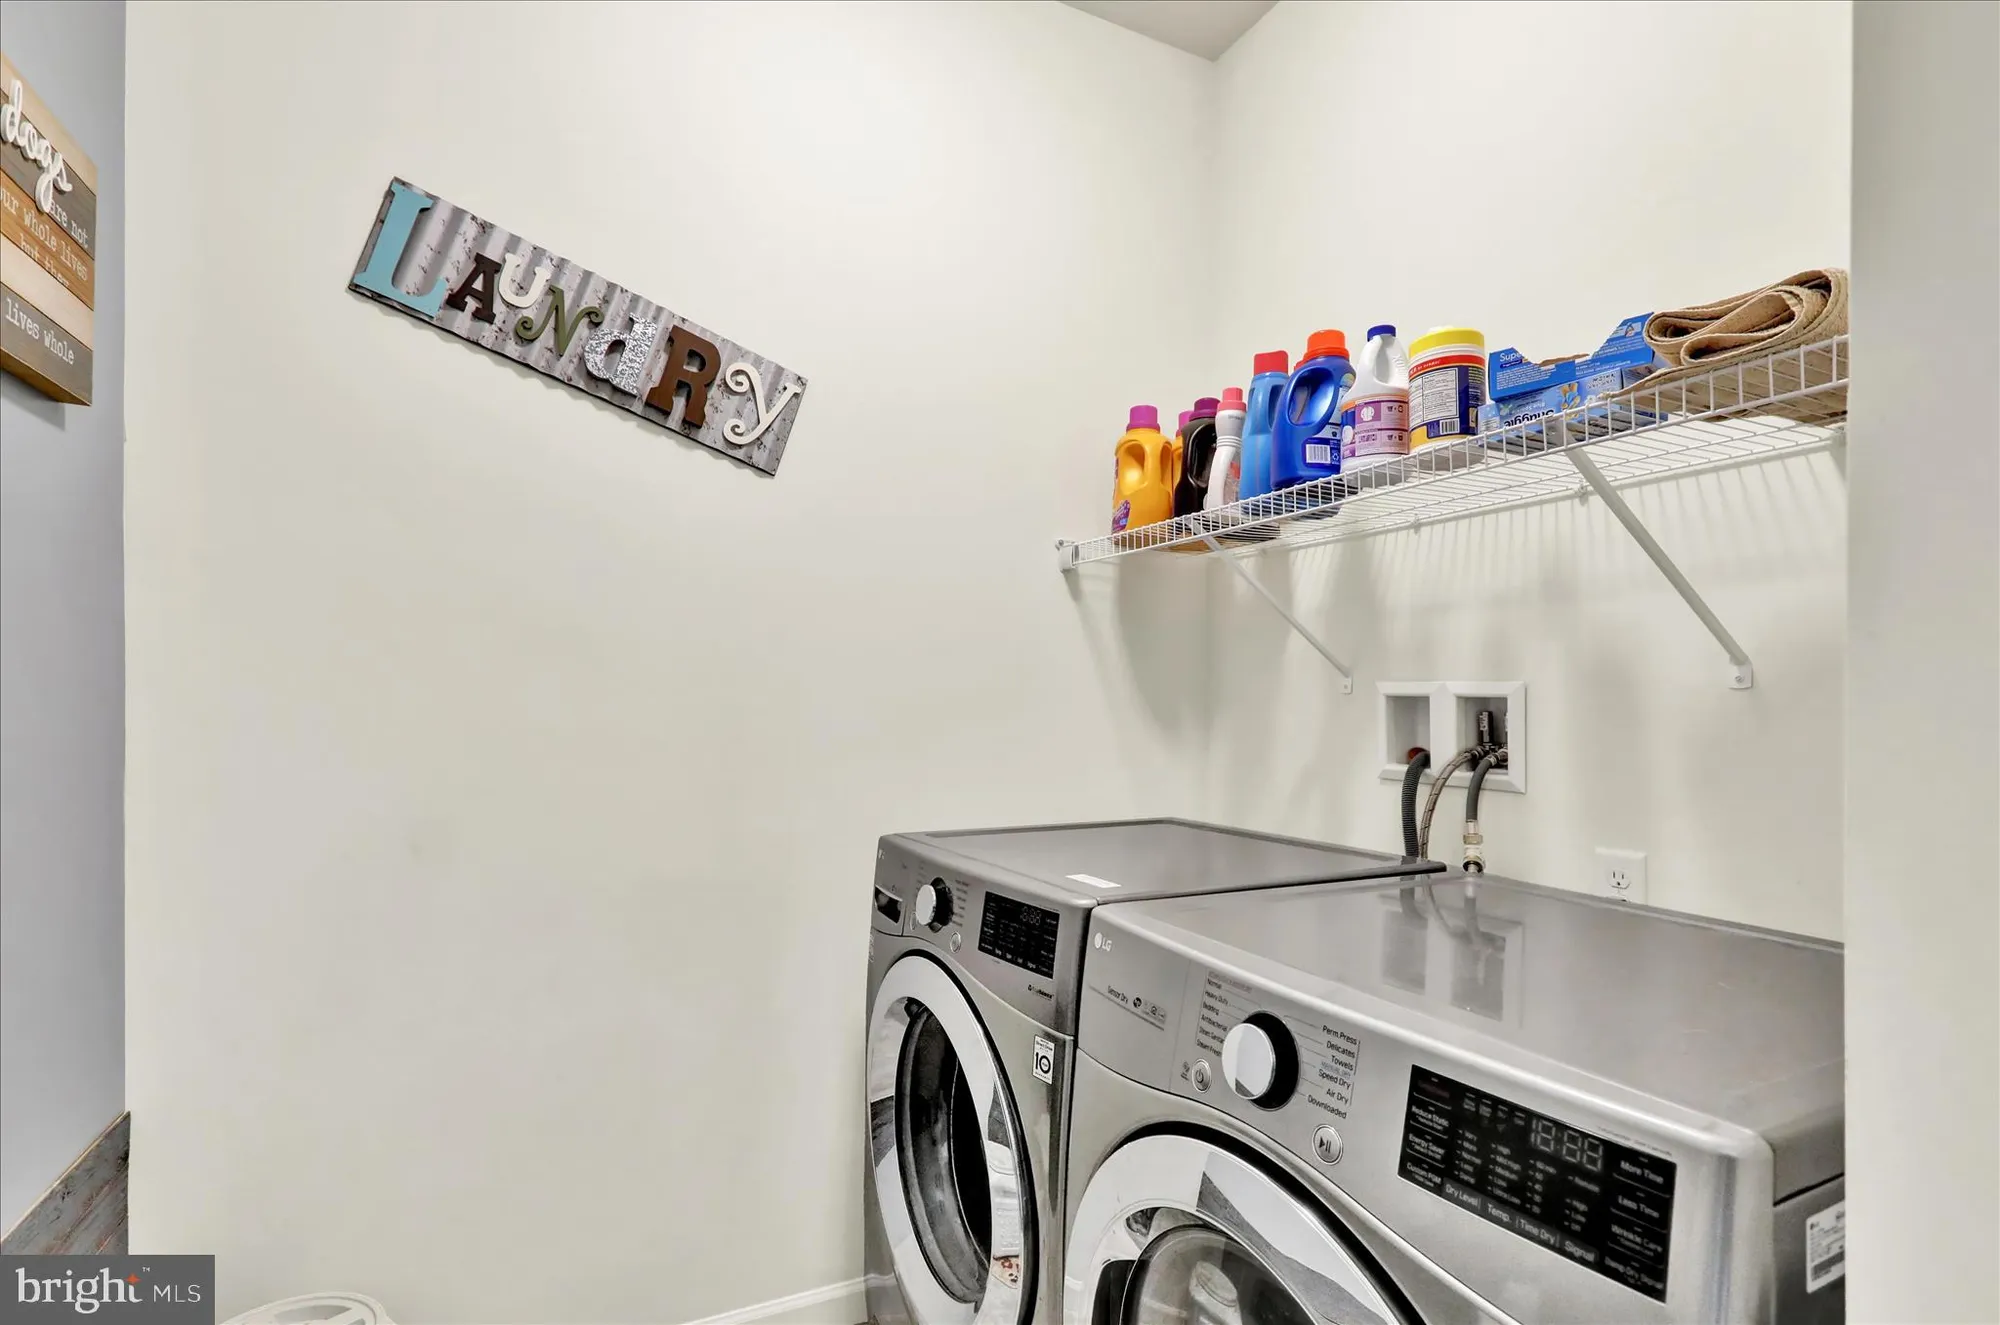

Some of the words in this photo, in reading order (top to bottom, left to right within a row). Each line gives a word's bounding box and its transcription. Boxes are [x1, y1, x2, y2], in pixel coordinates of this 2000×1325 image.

[1, 79, 73, 214] dogs
[0, 187, 19, 216] ur
[23, 207, 57, 251] whole
[61, 239, 88, 281] lives
[49, 199, 68, 227] are
[71, 220, 88, 249] not
[5, 297, 40, 340] lives
[43, 327, 75, 366] whole
[1101, 937, 1112, 951] LG
[1326, 1041, 1355, 1059] Delicates
[1331, 1055, 1353, 1071] Towels
[1318, 1068, 1338, 1084] Speed
[1339, 1079, 1351, 1091] Dry
[1307, 1094, 1347, 1119] Downloaded
[1326, 1088, 1336, 1098] Air
[1337, 1092, 1348, 1105] Dry
[1411, 1105, 1431, 1119] Reduce
[1431, 1114, 1449, 1127] Static
[1408, 1134, 1428, 1149] Energy
[1620, 1160, 1641, 1176] More
[1642, 1169, 1663, 1185] Time
[1445, 1184, 1458, 1198] Dry
[1458, 1190, 1478, 1208] Level
[1639, 1203, 1659, 1219] Time
[1520, 1219, 1537, 1235] Time
[1538, 1227, 1555, 1244] Dry
[1564, 1240, 1595, 1263] Signal
